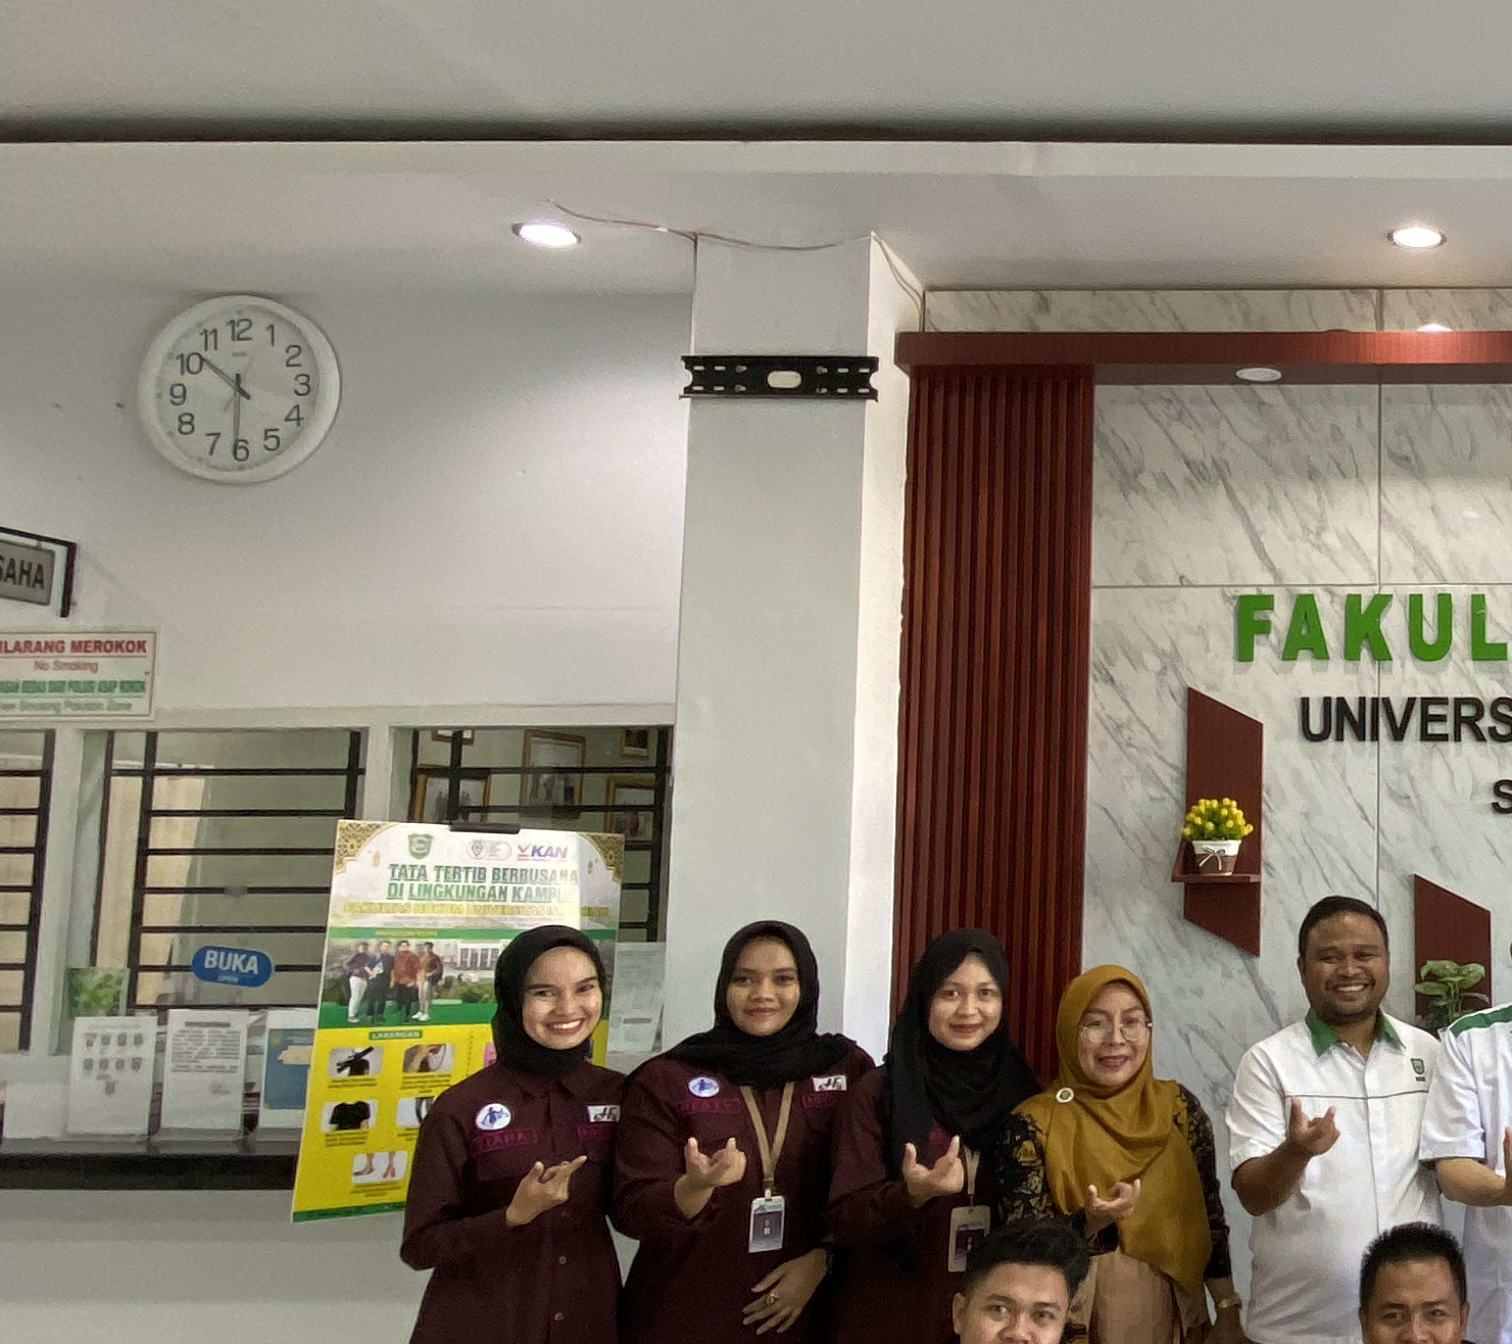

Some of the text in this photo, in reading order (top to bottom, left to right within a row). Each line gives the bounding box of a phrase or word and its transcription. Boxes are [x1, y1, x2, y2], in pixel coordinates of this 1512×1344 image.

[200, 328, 218, 352] 11
[226, 318, 252, 342] 12
[265, 324, 276, 348] 1
[176, 352, 204, 376] 10
[285, 344, 302, 368] 2
[169, 383, 187, 407] 9
[294, 373, 311, 397] 3
[178, 412, 195, 436] 8
[284, 404, 304, 427] 4
[205, 432, 221, 457] 7
[232, 439, 250, 462] 6
[263, 428, 281, 452] 5
[70, 639, 147, 653] MEROKOK
[531, 844, 568, 859] KAN
[389, 862, 429, 882] TATA
[433, 864, 488, 885] TERTIB
[386, 881, 404, 901] DI
[407, 882, 508, 904] LINGKUNGAN
[204, 949, 259, 975] BUKA
